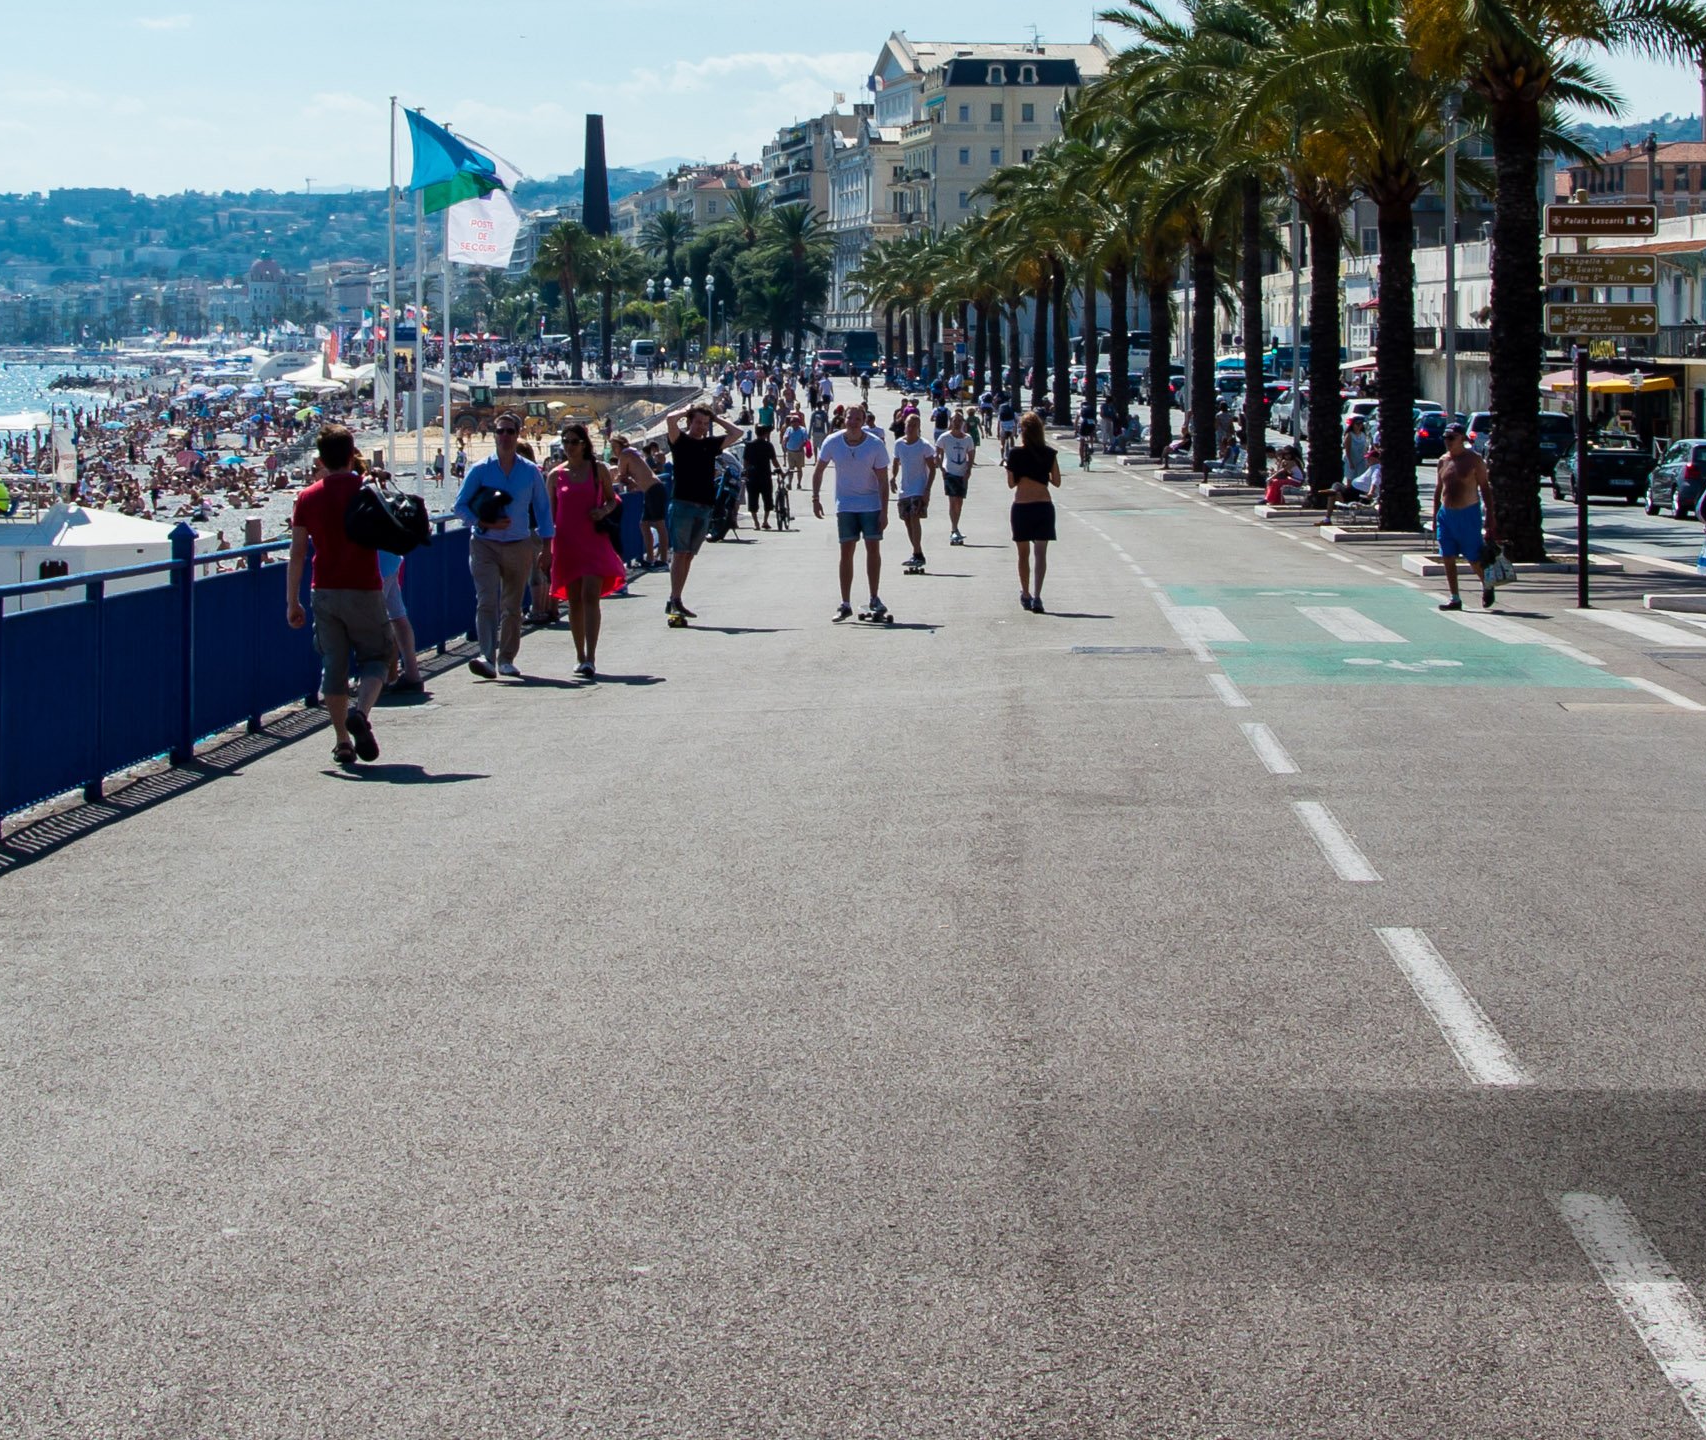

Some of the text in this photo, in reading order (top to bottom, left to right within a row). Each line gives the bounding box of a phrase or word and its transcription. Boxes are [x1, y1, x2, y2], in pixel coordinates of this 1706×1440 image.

[470, 220, 494, 230] POSTE
[1563, 216, 1624, 225] Palais Lascaris
[477, 232, 487, 240] DE
